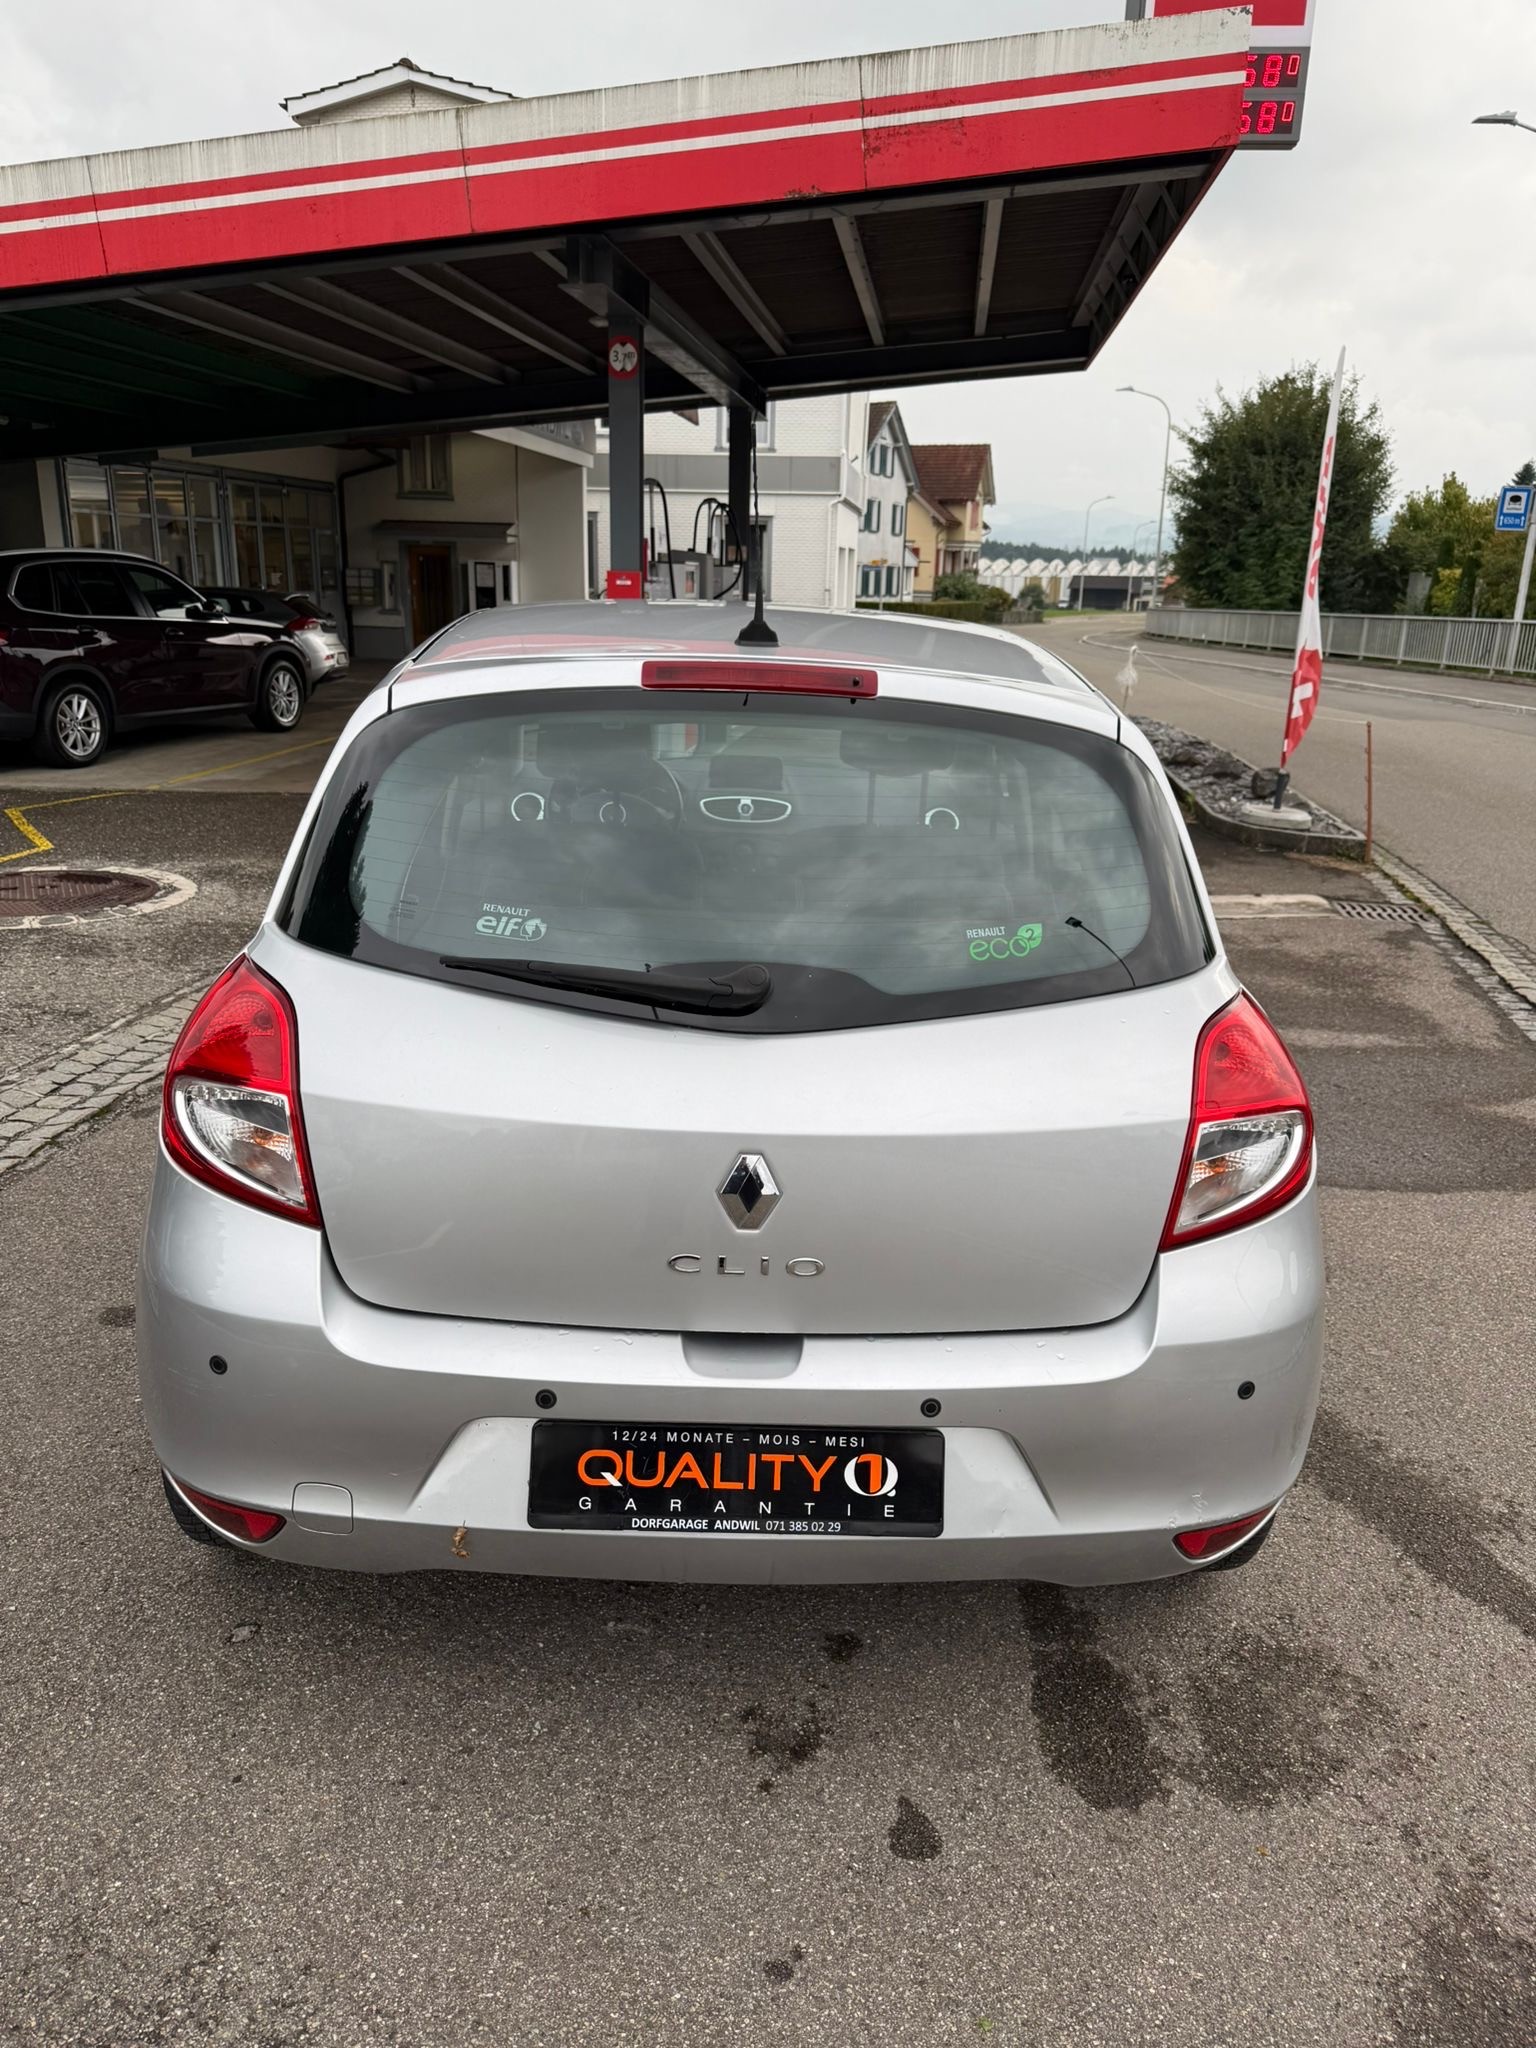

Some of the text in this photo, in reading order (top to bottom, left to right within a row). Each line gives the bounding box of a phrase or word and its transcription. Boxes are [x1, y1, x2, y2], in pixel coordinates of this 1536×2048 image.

[482, 903, 530, 917] RENAULT
[475, 916, 523, 936] elf
[966, 926, 1006, 939] RENAULT
[612, 1430, 657, 1442] 12/24
[666, 1431, 734, 1444] MONATE
[759, 1434, 800, 1446] MOIS
[825, 1436, 865, 1447] MESI
[577, 1449, 838, 1492] QUALITY
[578, 1496, 895, 1518] GARANTIE
[631, 1517, 841, 1532] DORFGARAGE ANDWIL 071 385 02 29
